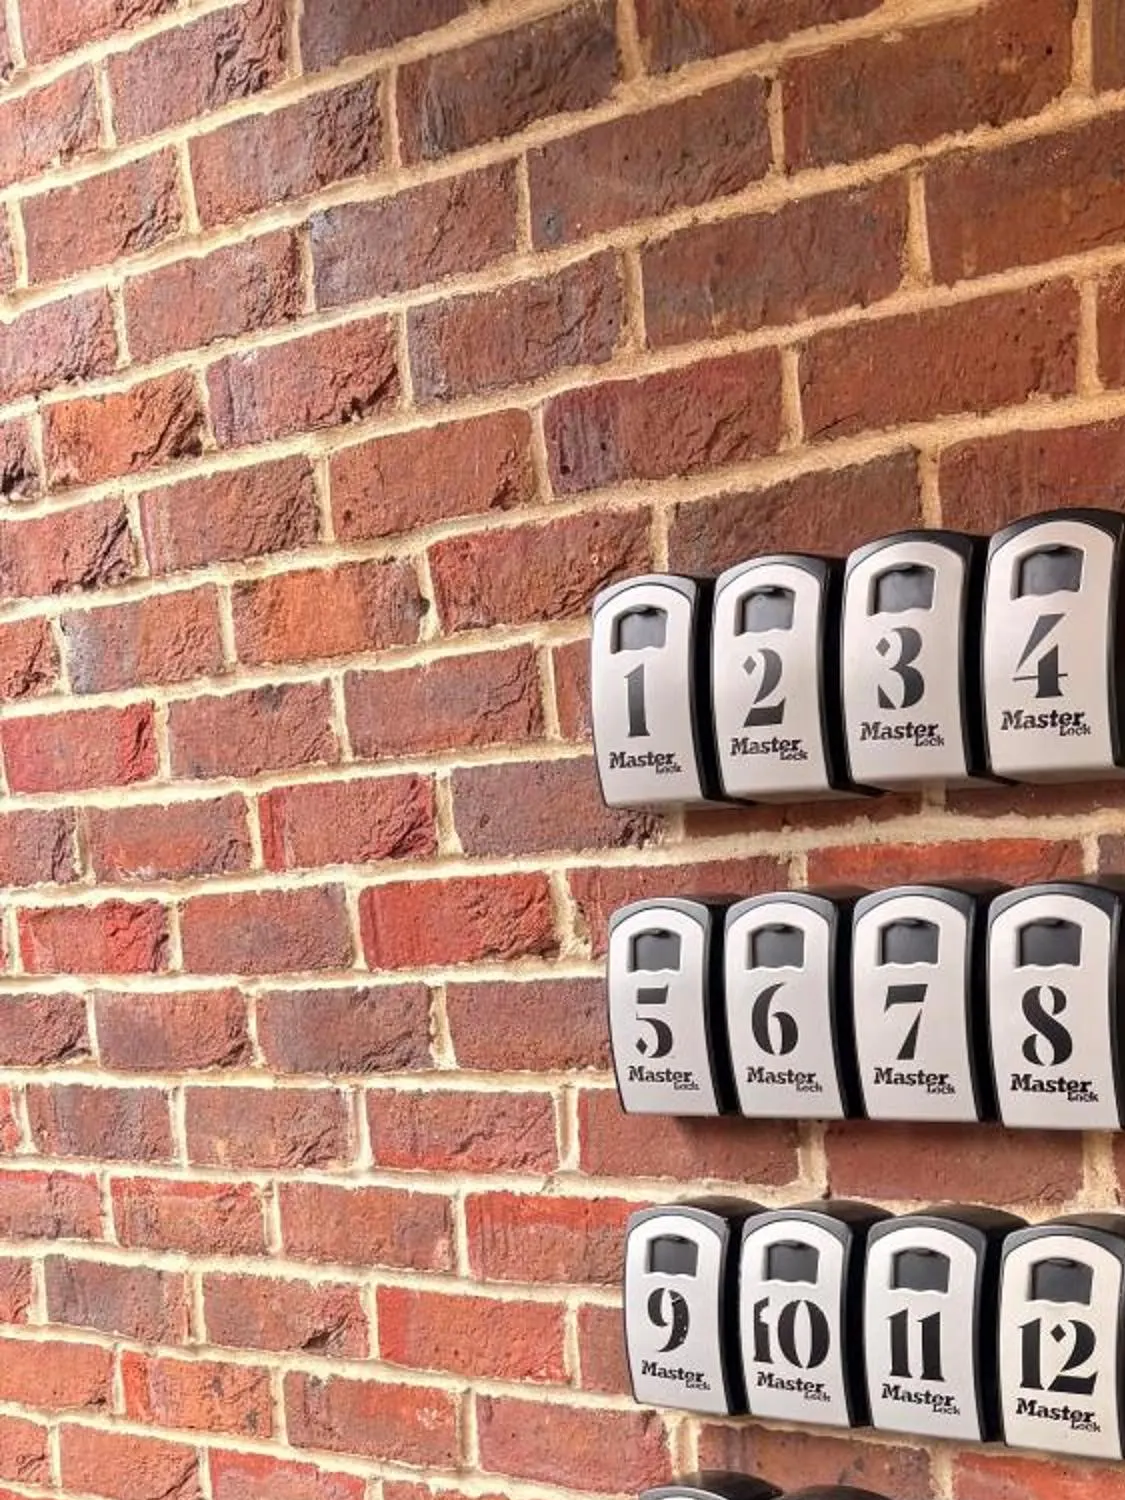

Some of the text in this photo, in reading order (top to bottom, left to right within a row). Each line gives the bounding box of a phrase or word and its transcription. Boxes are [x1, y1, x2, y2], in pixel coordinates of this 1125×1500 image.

[876, 627, 925, 710] 3
[1013, 613, 1068, 699] 4
[623, 664, 650, 738] 1
[743, 647, 786, 727] 2
[860, 721, 939, 742] Master
[1001, 708, 1085, 730] Master
[609, 751, 674, 770] Master
[729, 737, 801, 757] Master
[635, 986, 674, 1058] 5
[751, 982, 799, 1056] 6
[883, 984, 928, 1061] 7
[1021, 985, 1073, 1067] 8
[627, 1066, 693, 1085] Master
[746, 1066, 816, 1086] Master
[873, 1067, 949, 1088] Master
[1010, 1074, 1093, 1095] Master
[648, 1288, 690, 1353] 9
[753, 1296, 831, 1369] 10
[888, 1309, 945, 1382] 11
[1017, 1317, 1098, 1396] 12
[642, 1360, 704, 1382] Master
[757, 1372, 826, 1394] Master
[882, 1383, 956, 1408] Master
[1016, 1398, 1096, 1424] Master
